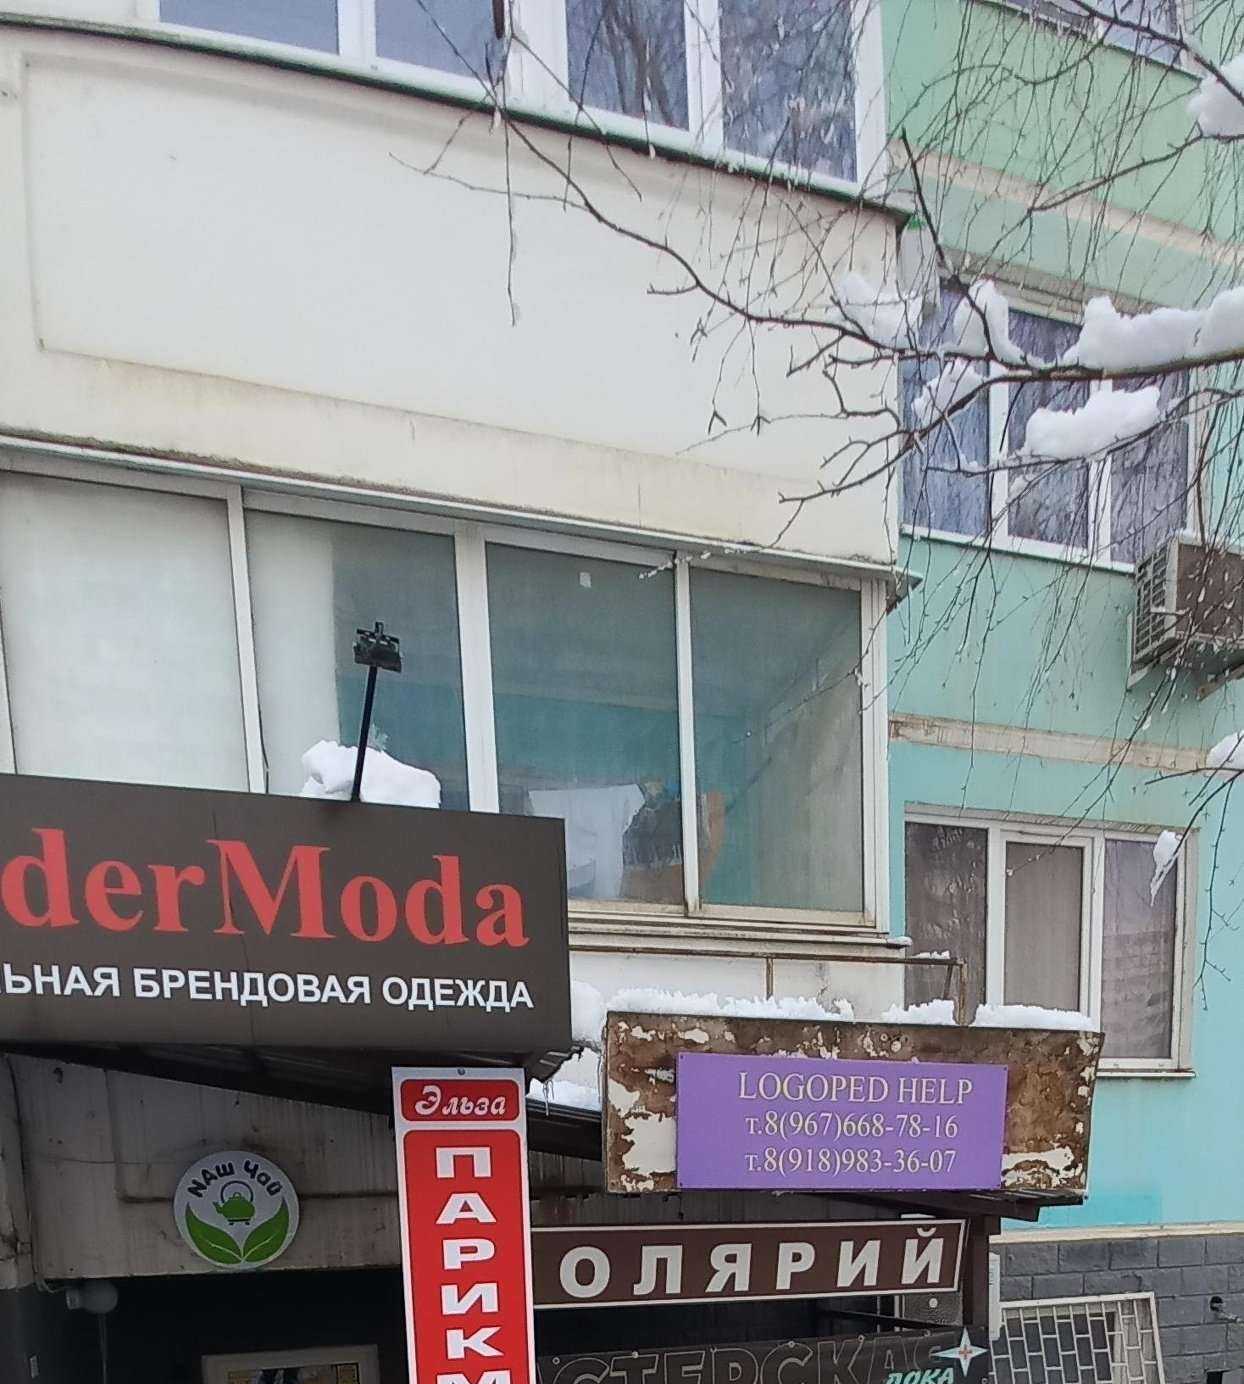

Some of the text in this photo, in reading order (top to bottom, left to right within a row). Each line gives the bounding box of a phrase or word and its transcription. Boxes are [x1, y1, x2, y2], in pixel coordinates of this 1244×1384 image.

[2, 828, 530, 948] derModa
[0, 962, 534, 1012] ЬНАЯ БРЕНДОВАЯ ОДЕЖДА
[414, 1084, 506, 1115] Эльза
[738, 1072, 973, 1106] LOGOPED HELP
[744, 1112, 959, 1143] т.8(967)668-78-16
[744, 1149, 957, 1177] т.8(918)983-36-07
